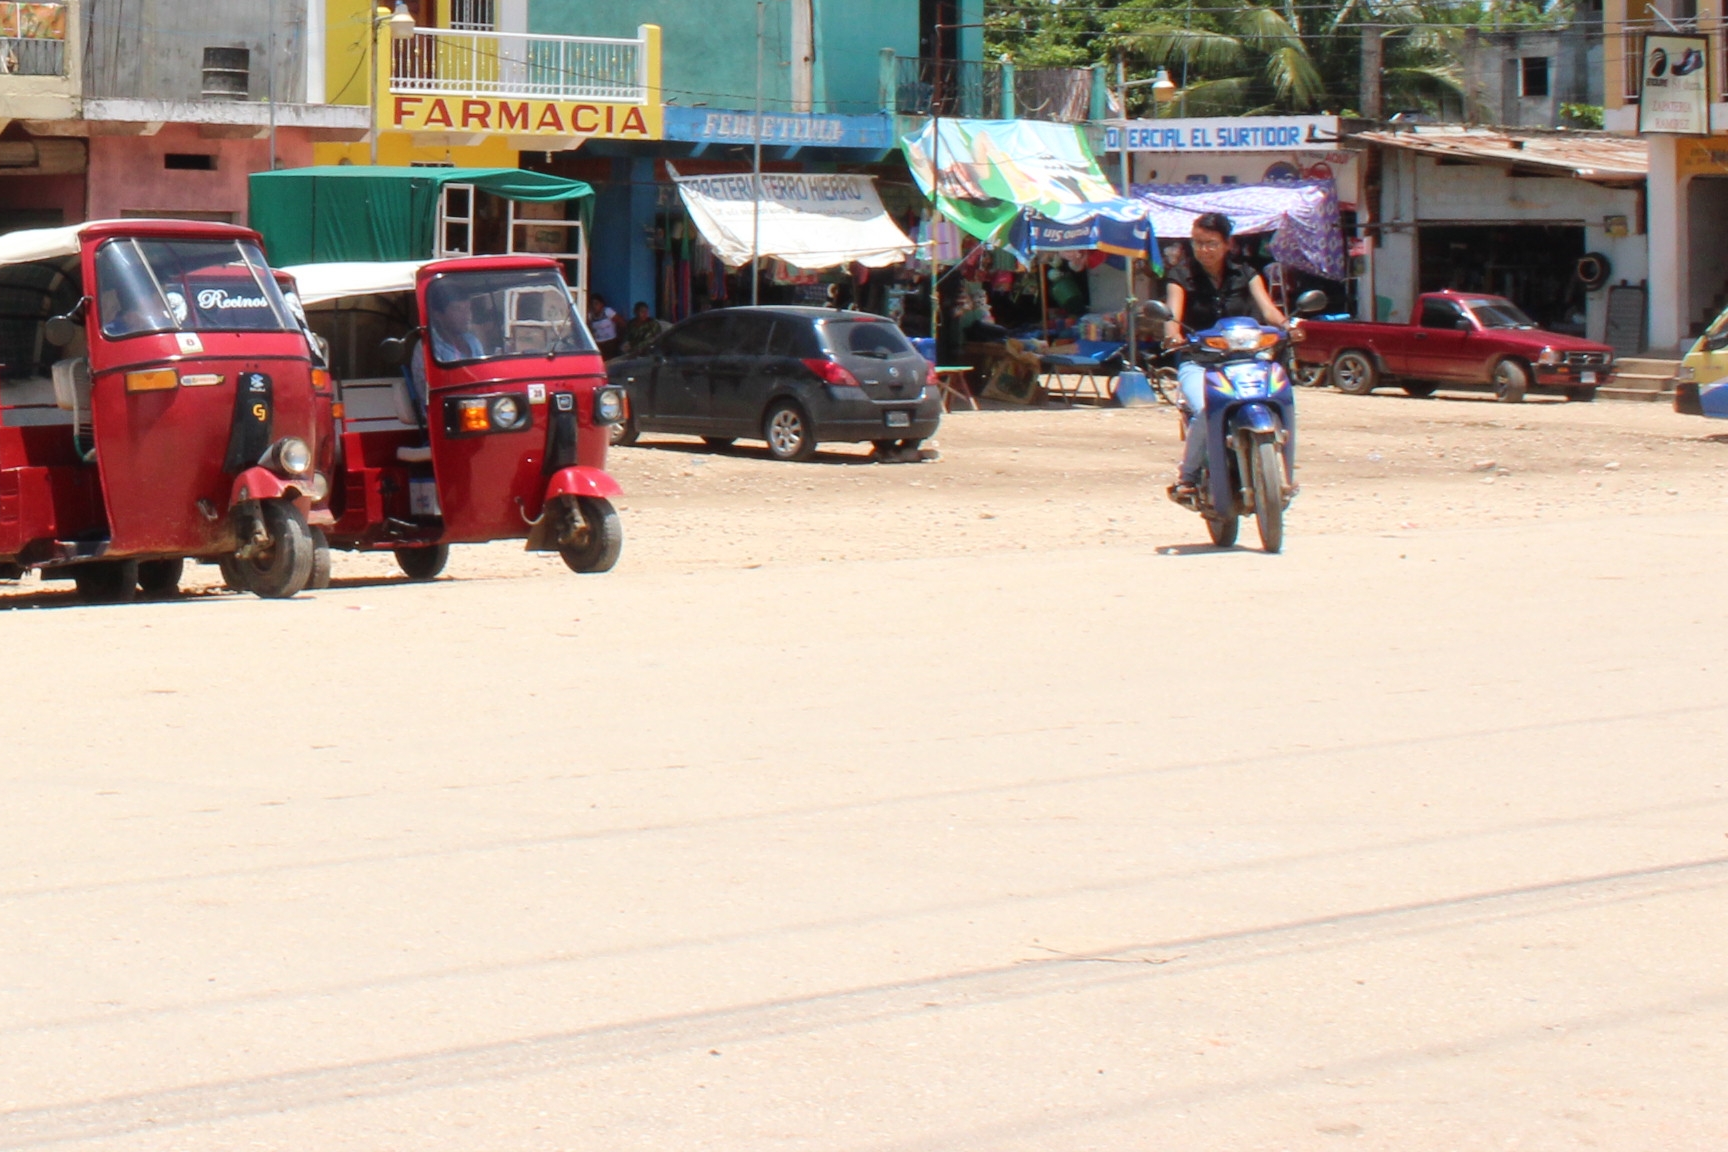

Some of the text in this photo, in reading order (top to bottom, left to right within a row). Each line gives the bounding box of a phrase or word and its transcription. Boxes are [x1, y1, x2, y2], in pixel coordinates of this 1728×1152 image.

[394, 97, 648, 135] FARMACIA
[1191, 128, 1213, 147] EL
[1216, 126, 1300, 147] SURTIDOR
[763, 175, 808, 201] FERRO
[808, 176, 861, 201] HIERRO
